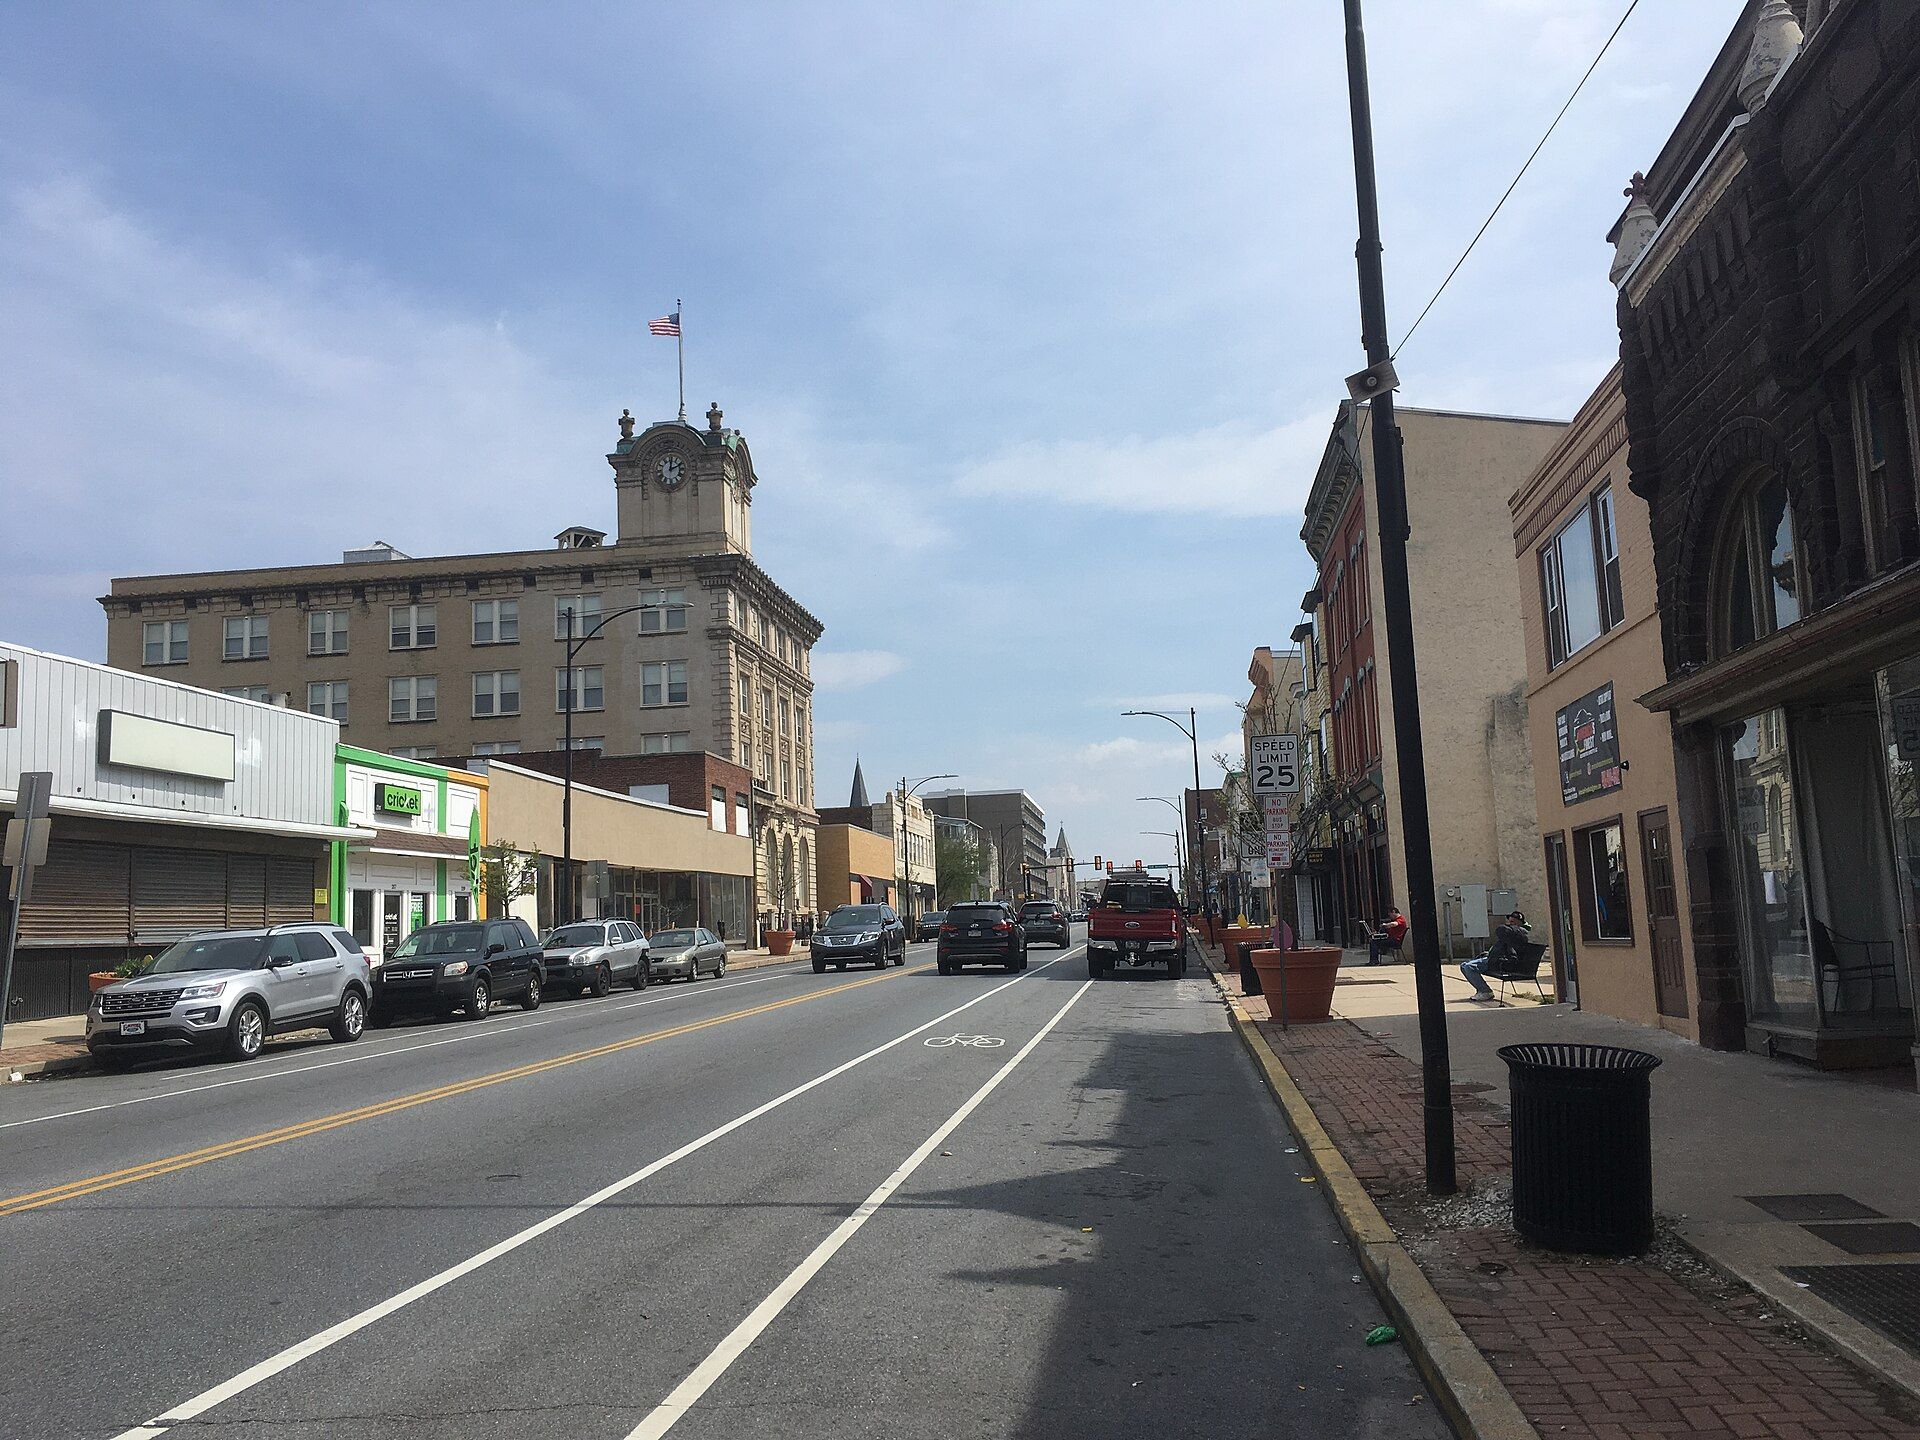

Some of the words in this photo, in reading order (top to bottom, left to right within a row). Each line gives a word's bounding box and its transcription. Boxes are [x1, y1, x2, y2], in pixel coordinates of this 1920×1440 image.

[1254, 741, 1295, 751] SPEED
[1259, 753, 1291, 763] LIMIT
[1256, 765, 1295, 787] 25
[386, 791, 419, 810] cricket
[1271, 798, 1282, 807] NO
[1266, 808, 1288, 816] PARKING
